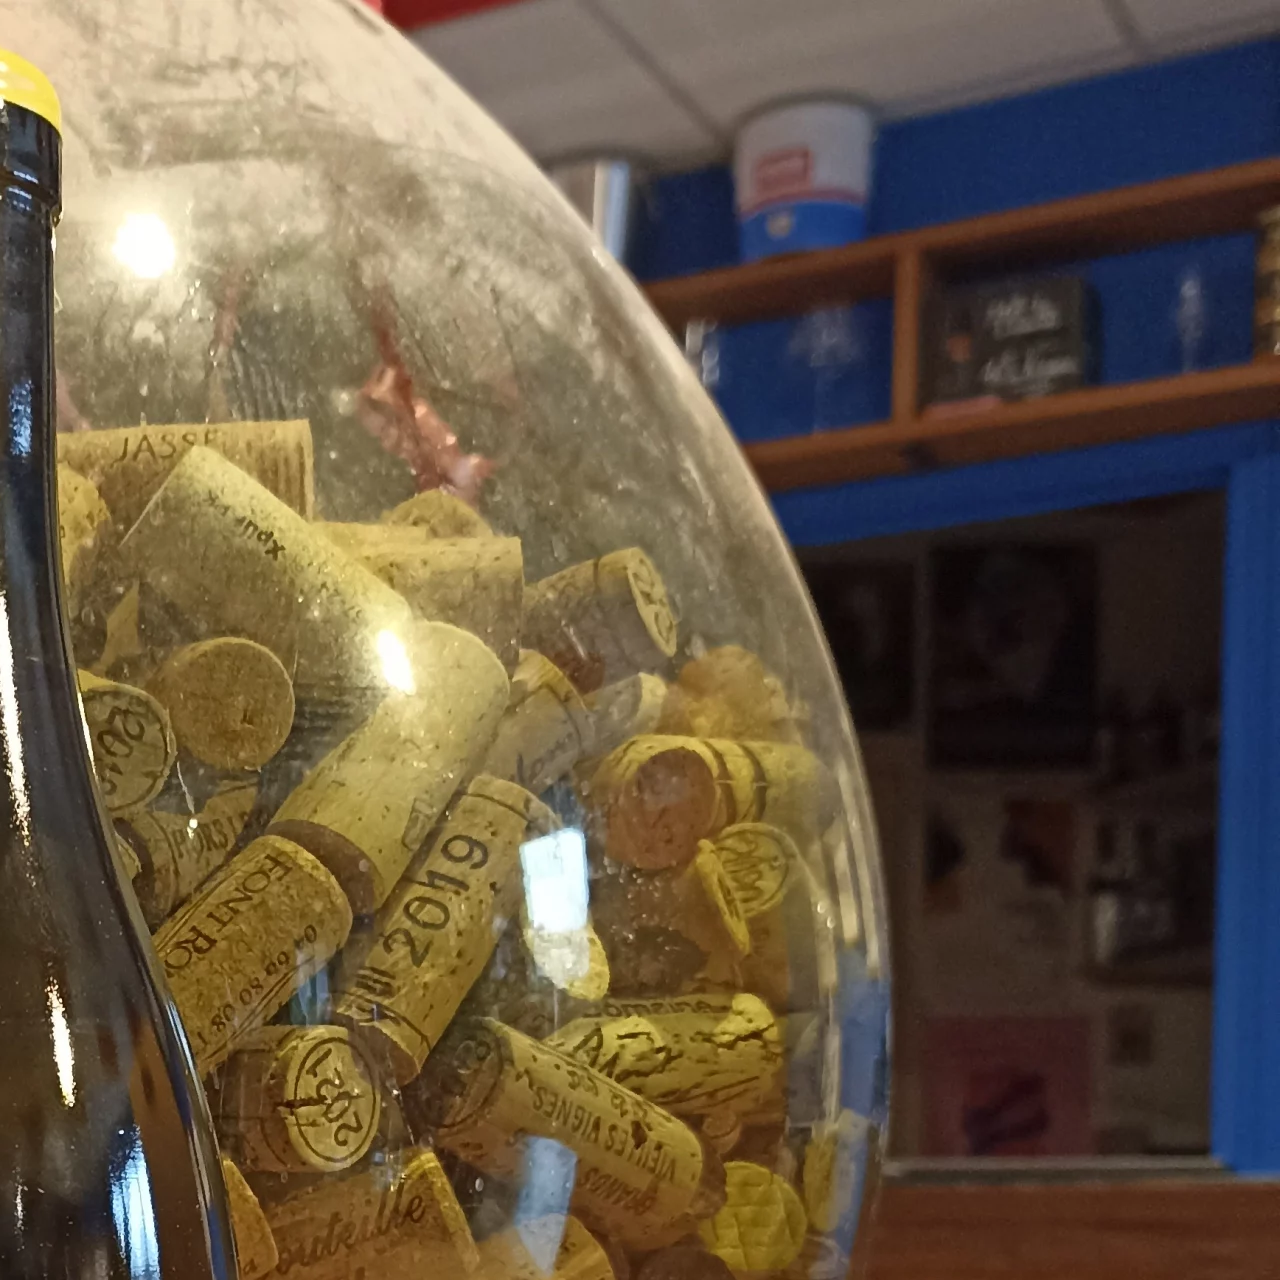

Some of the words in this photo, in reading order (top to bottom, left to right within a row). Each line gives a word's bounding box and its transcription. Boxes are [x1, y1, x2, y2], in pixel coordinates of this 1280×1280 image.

[206, 853, 294, 933] FONT
[380, 834, 489, 969] 2019
[163, 924, 218, 979] RO
[305, 1047, 365, 1148] 2021
[531, 1085, 602, 1149] VIGNES
[605, 1122, 678, 1184] VIEILLES
